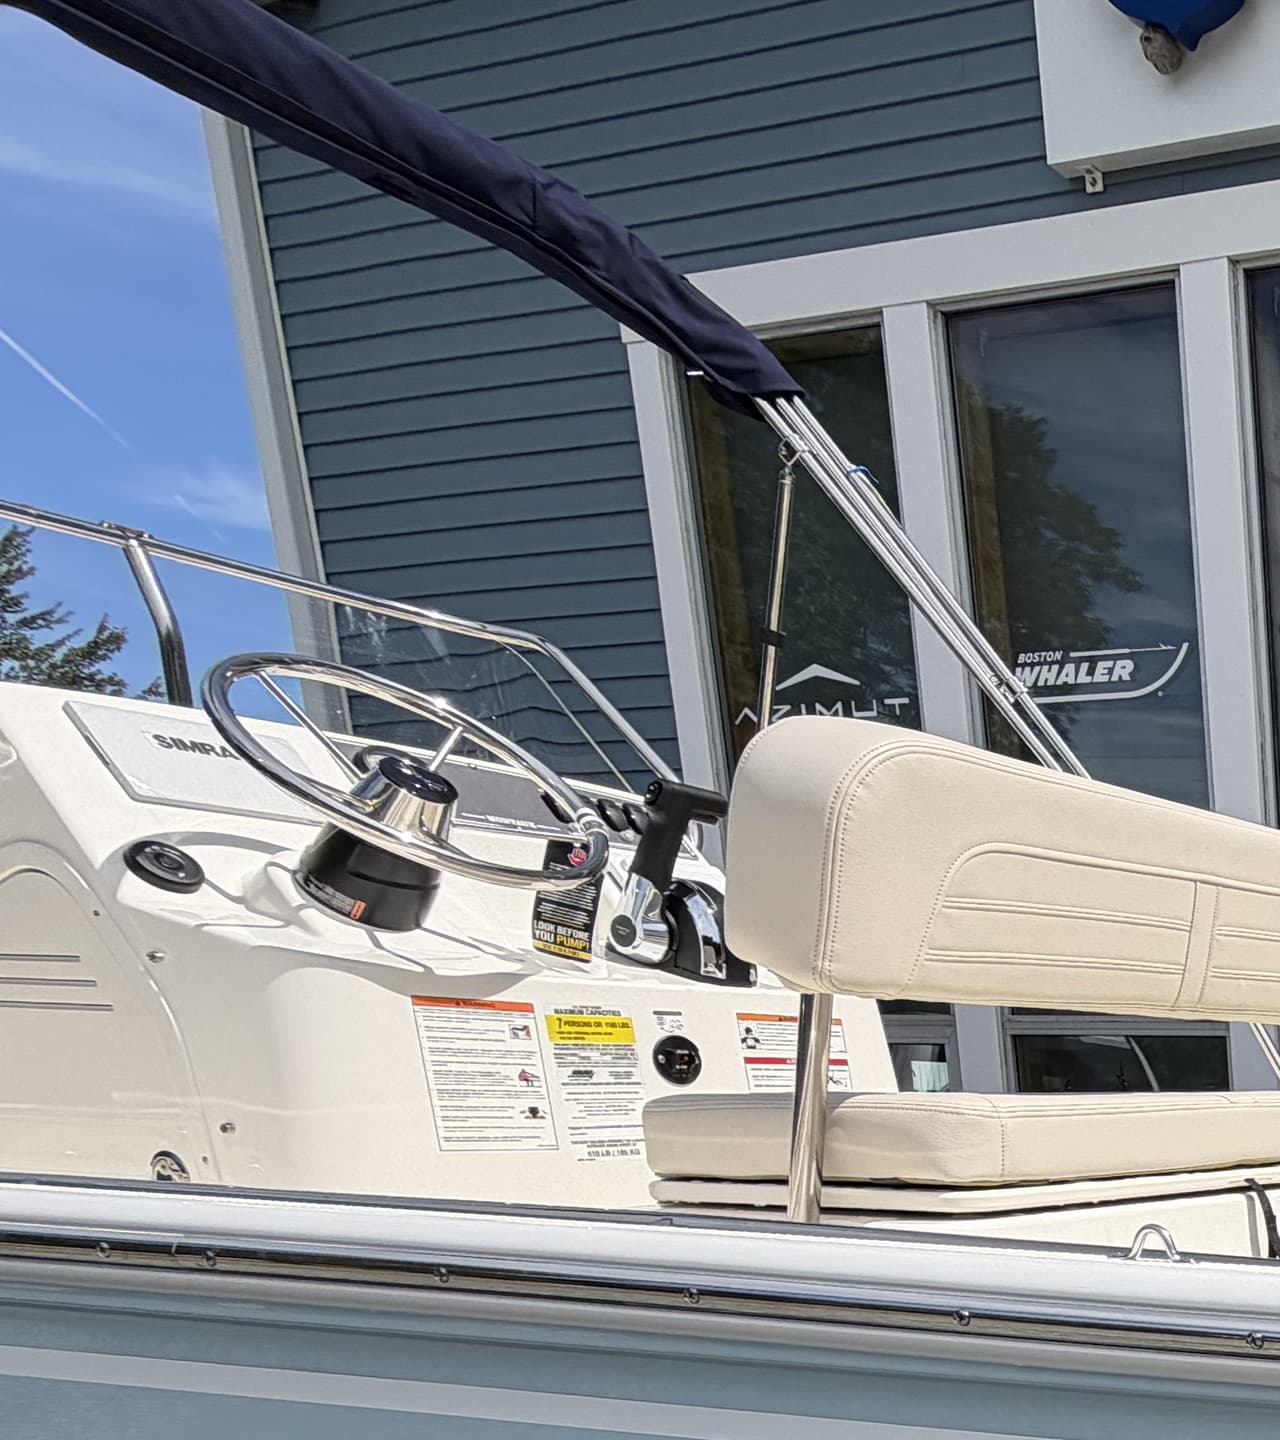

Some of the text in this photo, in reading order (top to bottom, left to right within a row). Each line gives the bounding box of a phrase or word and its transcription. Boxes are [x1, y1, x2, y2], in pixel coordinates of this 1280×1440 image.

[1017, 650, 1063, 664] BOSTON
[1015, 659, 1134, 687] WHALER
[735, 697, 910, 725] AZIMUT
[152, 734, 242, 760] SIMRA
[533, 919, 591, 941] LOOK BEFORE
[534, 930, 555, 943] YOU
